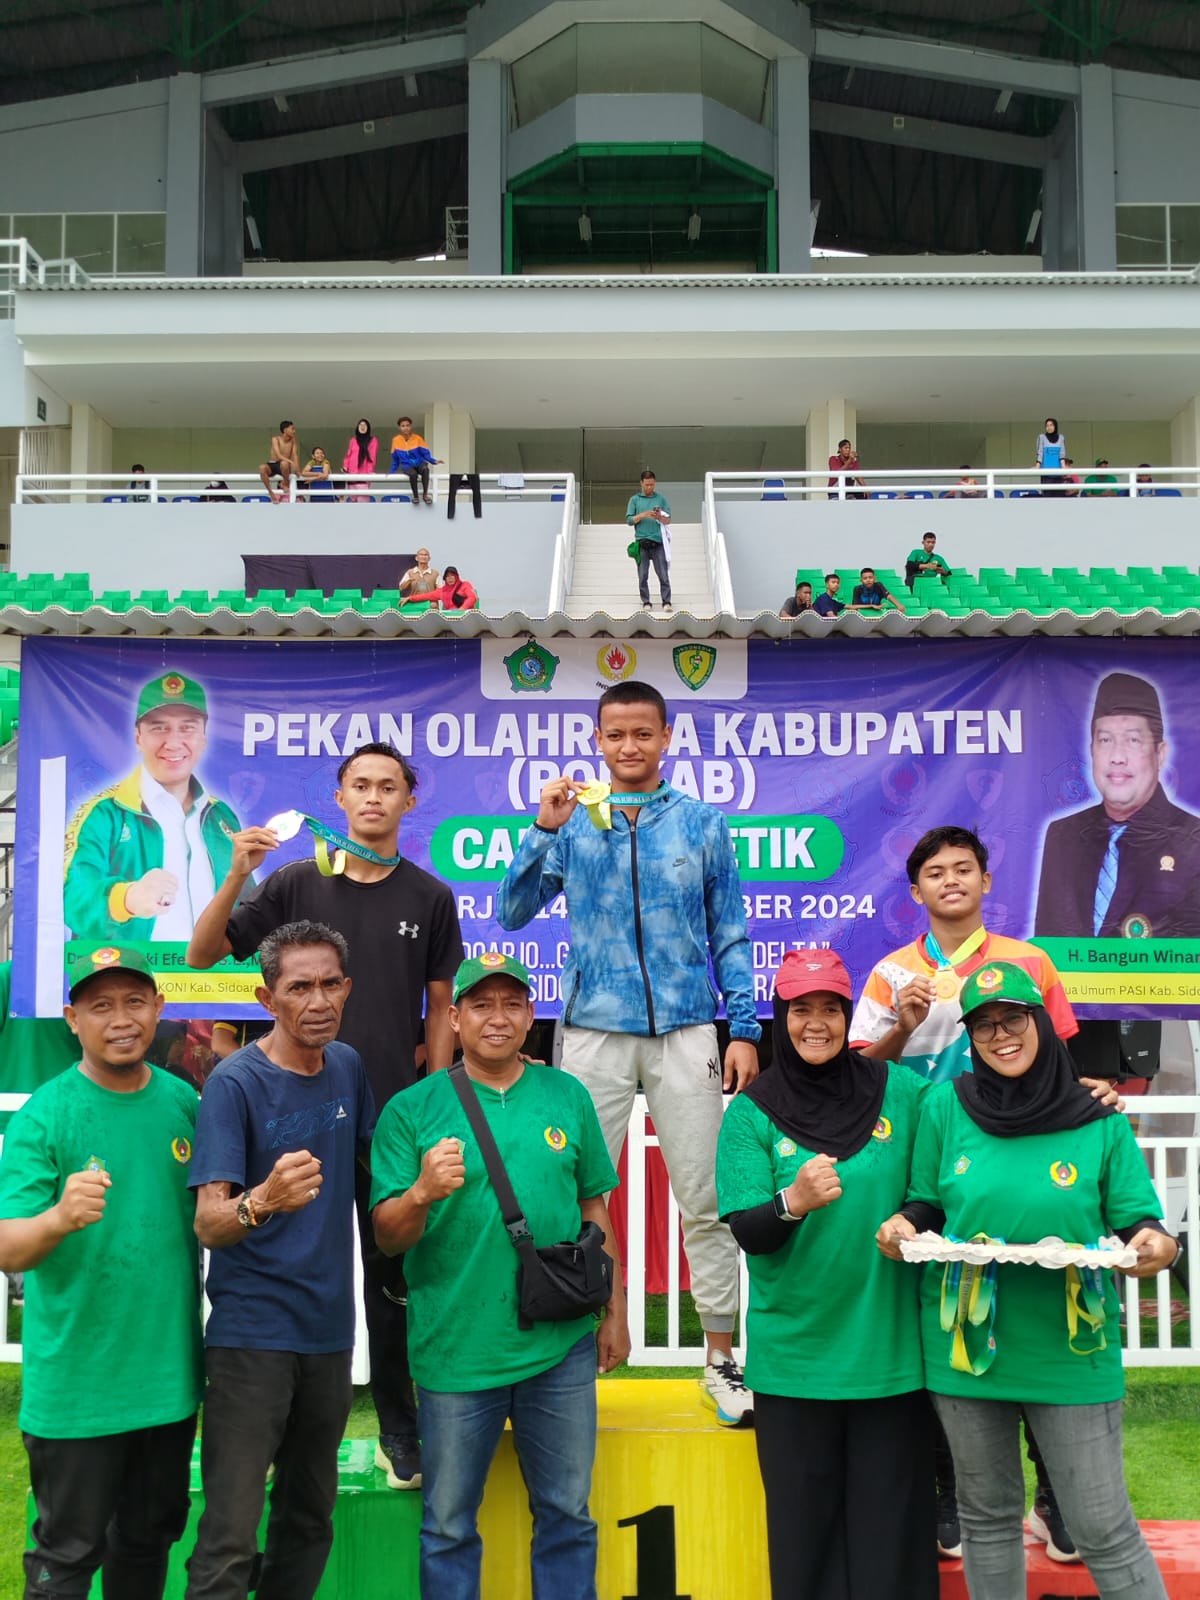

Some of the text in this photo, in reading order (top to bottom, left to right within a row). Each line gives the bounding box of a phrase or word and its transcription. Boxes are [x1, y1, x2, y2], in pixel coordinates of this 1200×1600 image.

[243, 710, 1022, 756] PEKAN OLAHRA KABUPATEN
[800, 895, 876, 919] 2024
[163, 953, 186, 965] Efe
[1068, 949, 1200, 966] H. Bangun Winar
[158, 982, 187, 993] KONI
[190, 982, 215, 993] Kab.
[1081, 986, 1116, 996] Umum
[1119, 985, 1146, 996] PASI
[1150, 985, 1175, 996] Kab.
[1178, 986, 1200, 996] Sido
[617, 1505, 692, 1600] 1
